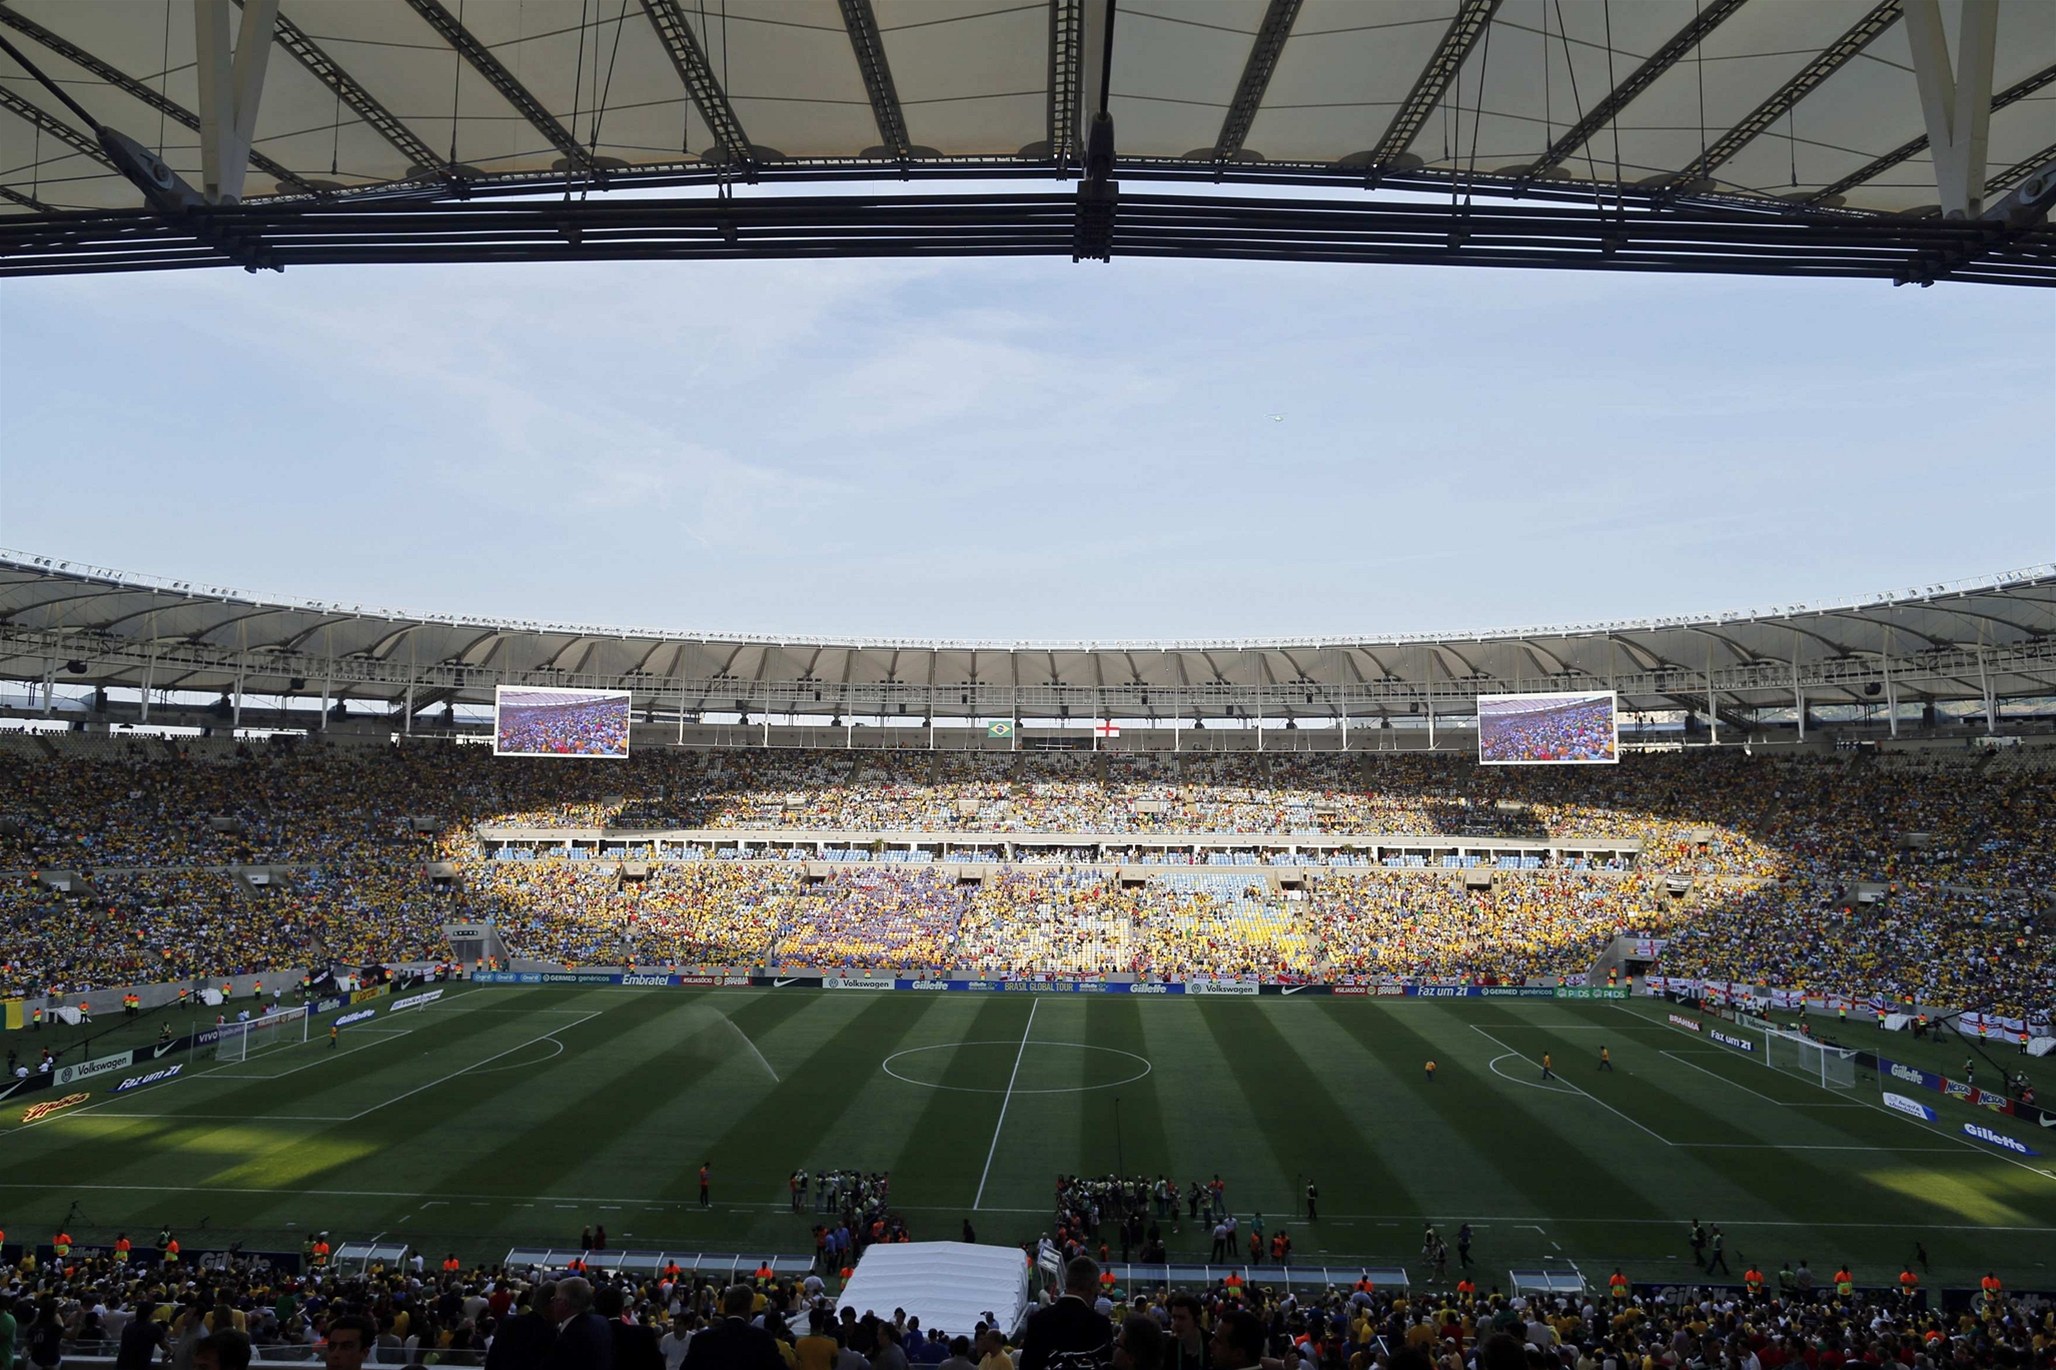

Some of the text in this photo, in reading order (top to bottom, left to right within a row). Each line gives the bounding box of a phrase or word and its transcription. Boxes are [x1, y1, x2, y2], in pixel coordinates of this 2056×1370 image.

[622, 974, 669, 986] Embratel
[843, 979, 889, 988] Volkswagen
[912, 980, 949, 990] Gillette
[1005, 982, 1028, 991] BRASIL
[1030, 982, 1055, 992] GLOBAL
[1056, 983, 1073, 992] TOUR
[1129, 984, 1167, 993] Gillette
[1206, 984, 1253, 994] Volkswagen
[1417, 987, 1436, 996] Faz
[1456, 987, 1469, 996] 21
[1668, 1014, 1700, 1031] BRAHMA
[1711, 1030, 1751, 1050] Faz um 21
[78, 1056, 127, 1076] Volkswagen
[1890, 1063, 1924, 1085] Gillette
[117, 1077, 139, 1091] Faz
[145, 1070, 164, 1083] um
[1963, 1122, 2027, 1153] Gillette
